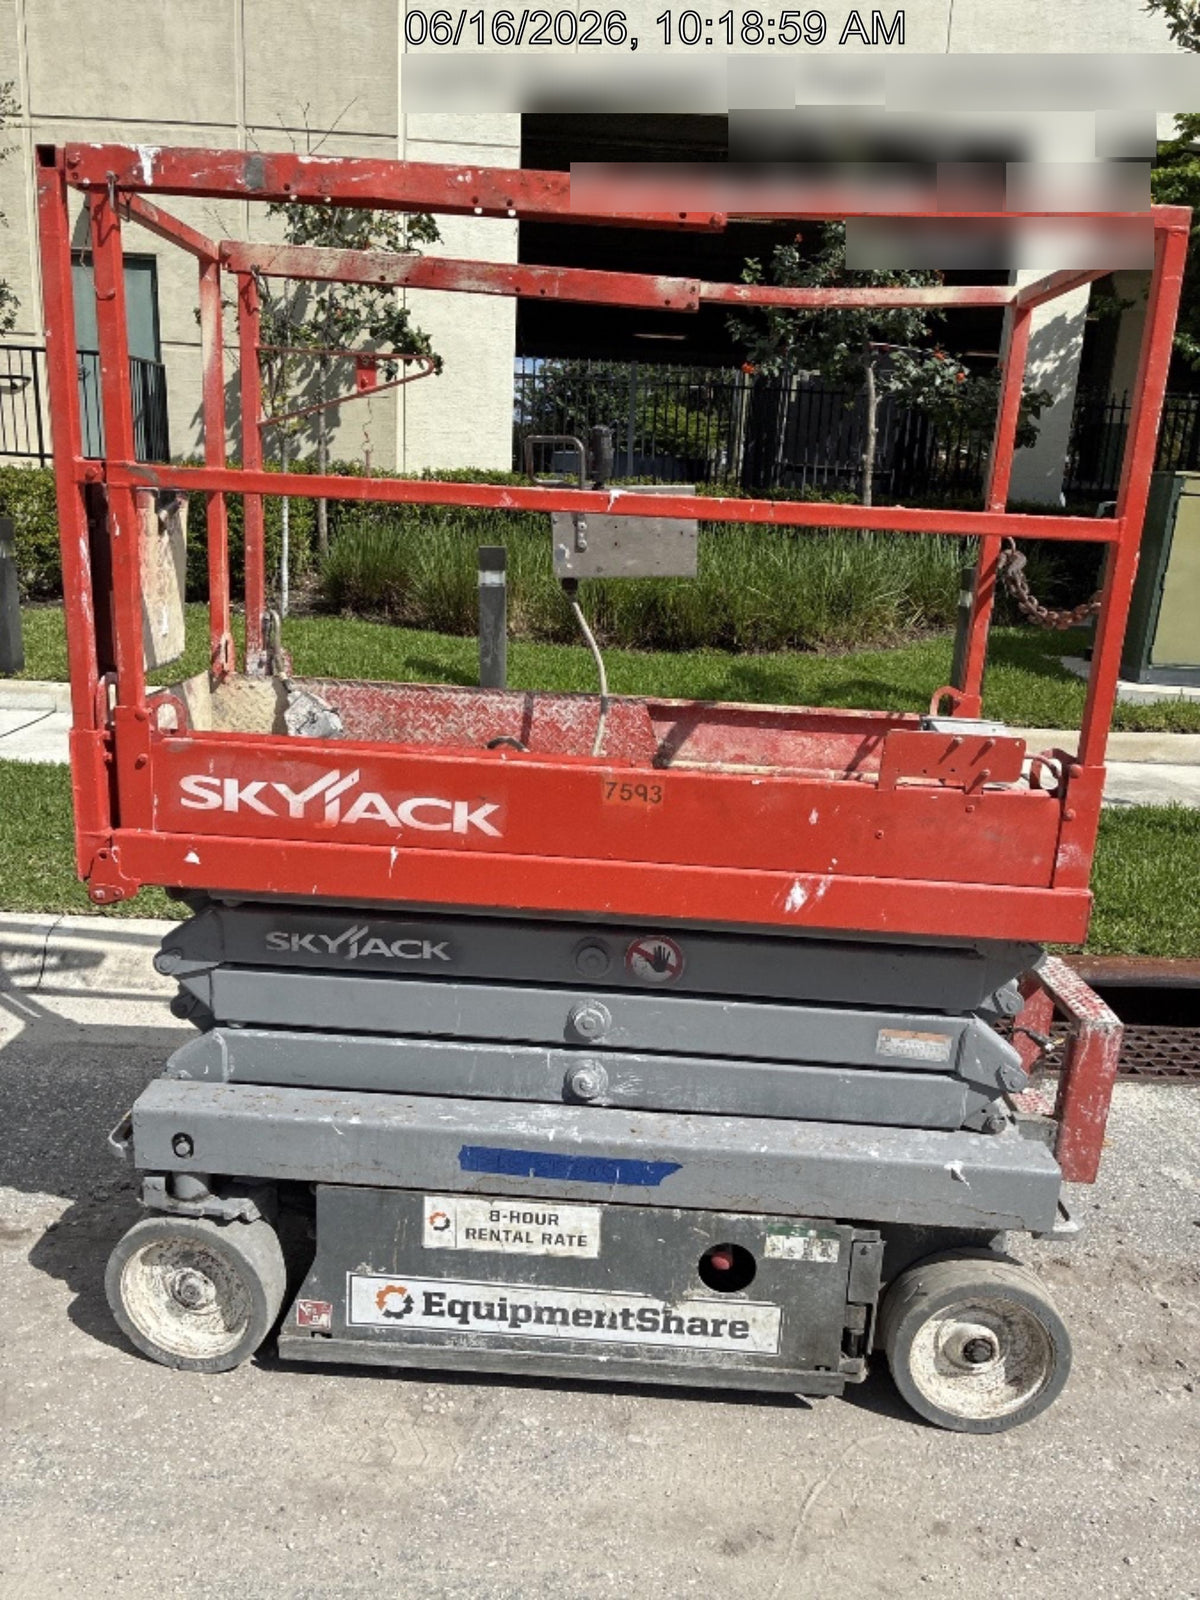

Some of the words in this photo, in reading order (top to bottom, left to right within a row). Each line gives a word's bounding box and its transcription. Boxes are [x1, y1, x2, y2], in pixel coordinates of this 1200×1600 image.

[179, 768, 503, 837] SKYJACK
[605, 781, 663, 805] 7593
[265, 924, 452, 962] SKYJACK
[489, 1210, 559, 1226] 8-HOUR
[465, 1228, 535, 1244] RENTAL
[541, 1233, 588, 1247] RATE
[421, 1291, 750, 1340] EquipmentShare
